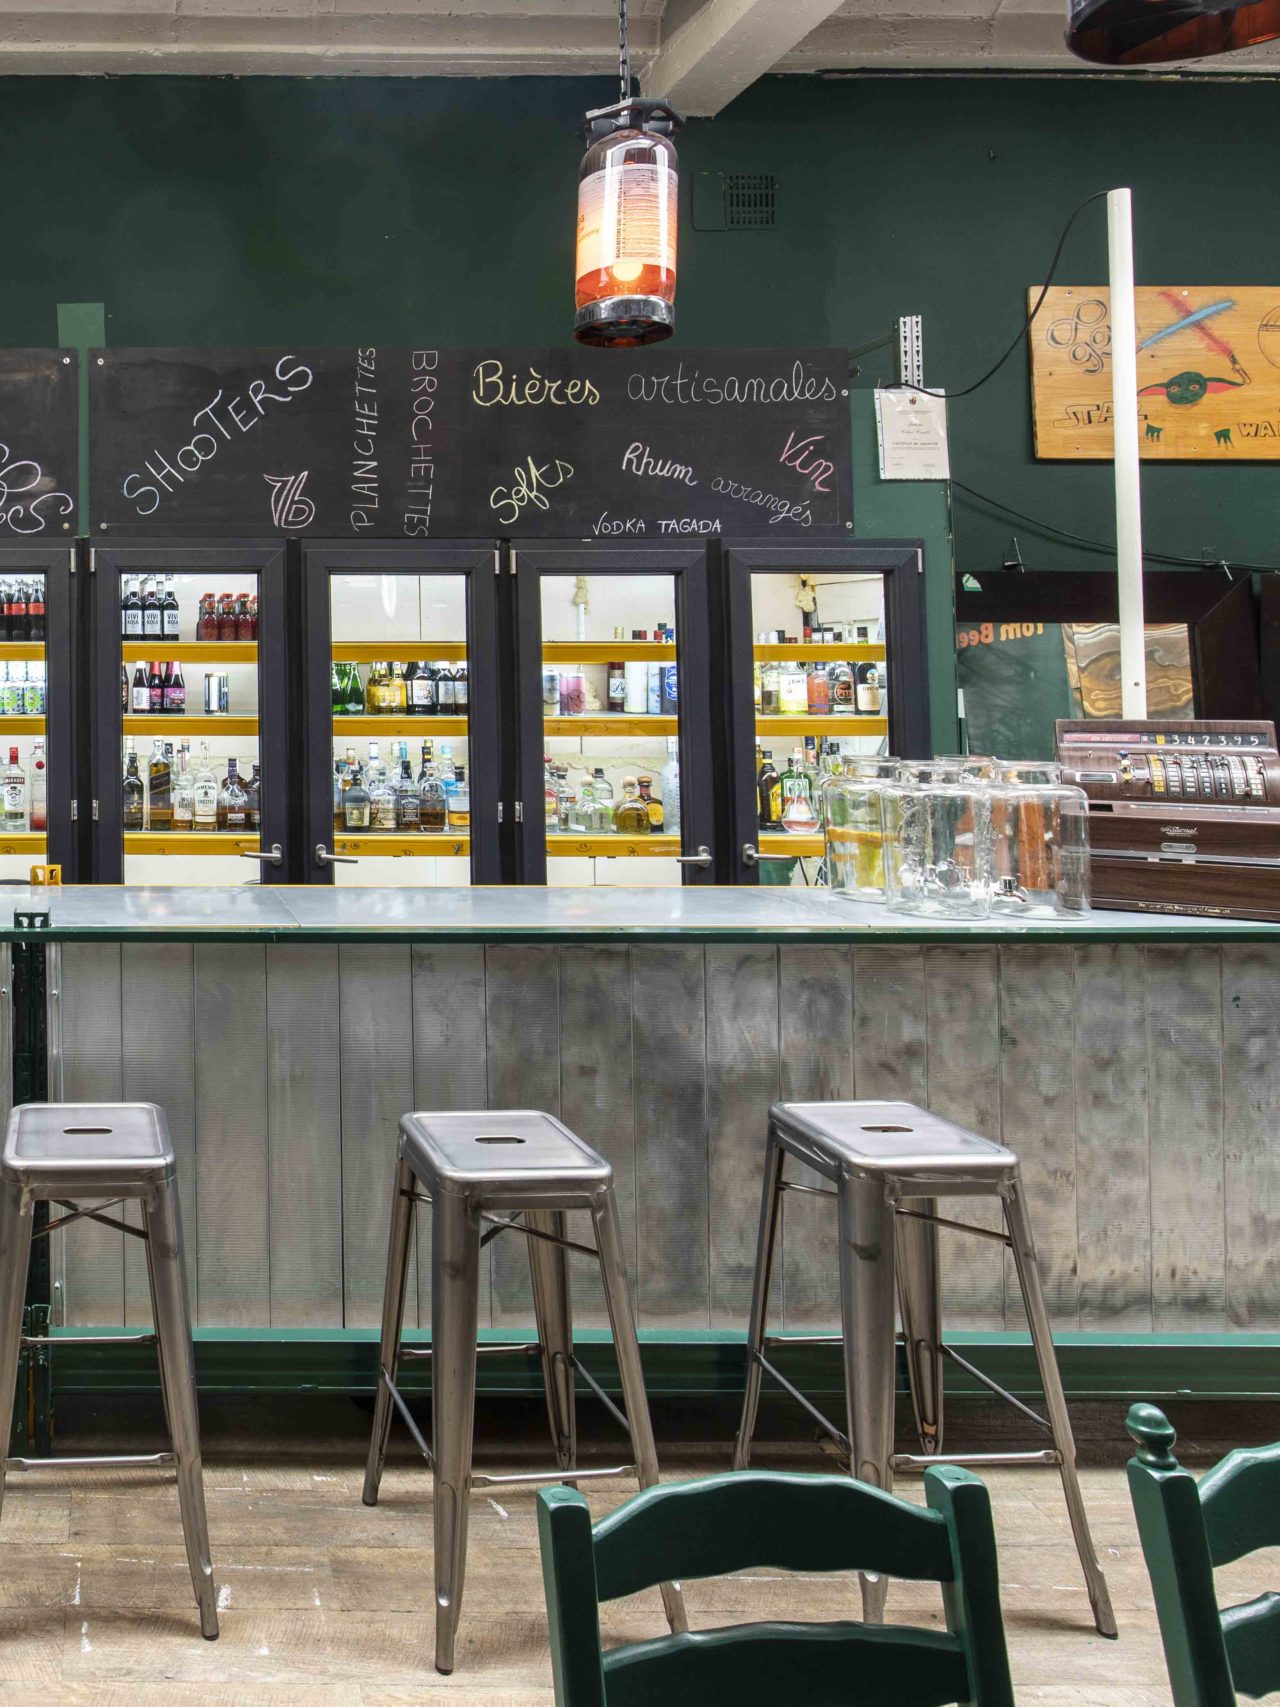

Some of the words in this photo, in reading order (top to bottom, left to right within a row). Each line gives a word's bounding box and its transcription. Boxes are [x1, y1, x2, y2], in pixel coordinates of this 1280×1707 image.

[473, 359, 601, 406] Bières
[626, 360, 838, 404] artisanales
[123, 355, 314, 515] SHOOTERS
[350, 347, 379, 532] PLANCHETTES
[403, 350, 439, 536] BROCHETTES
[778, 430, 836, 492] Vin
[1237, 420, 1280, 437] WA
[621, 441, 699, 487] Rhum
[710, 476, 813, 527] arrangés
[592, 511, 646, 535] VODKA
[656, 519, 722, 534] TAGADA
